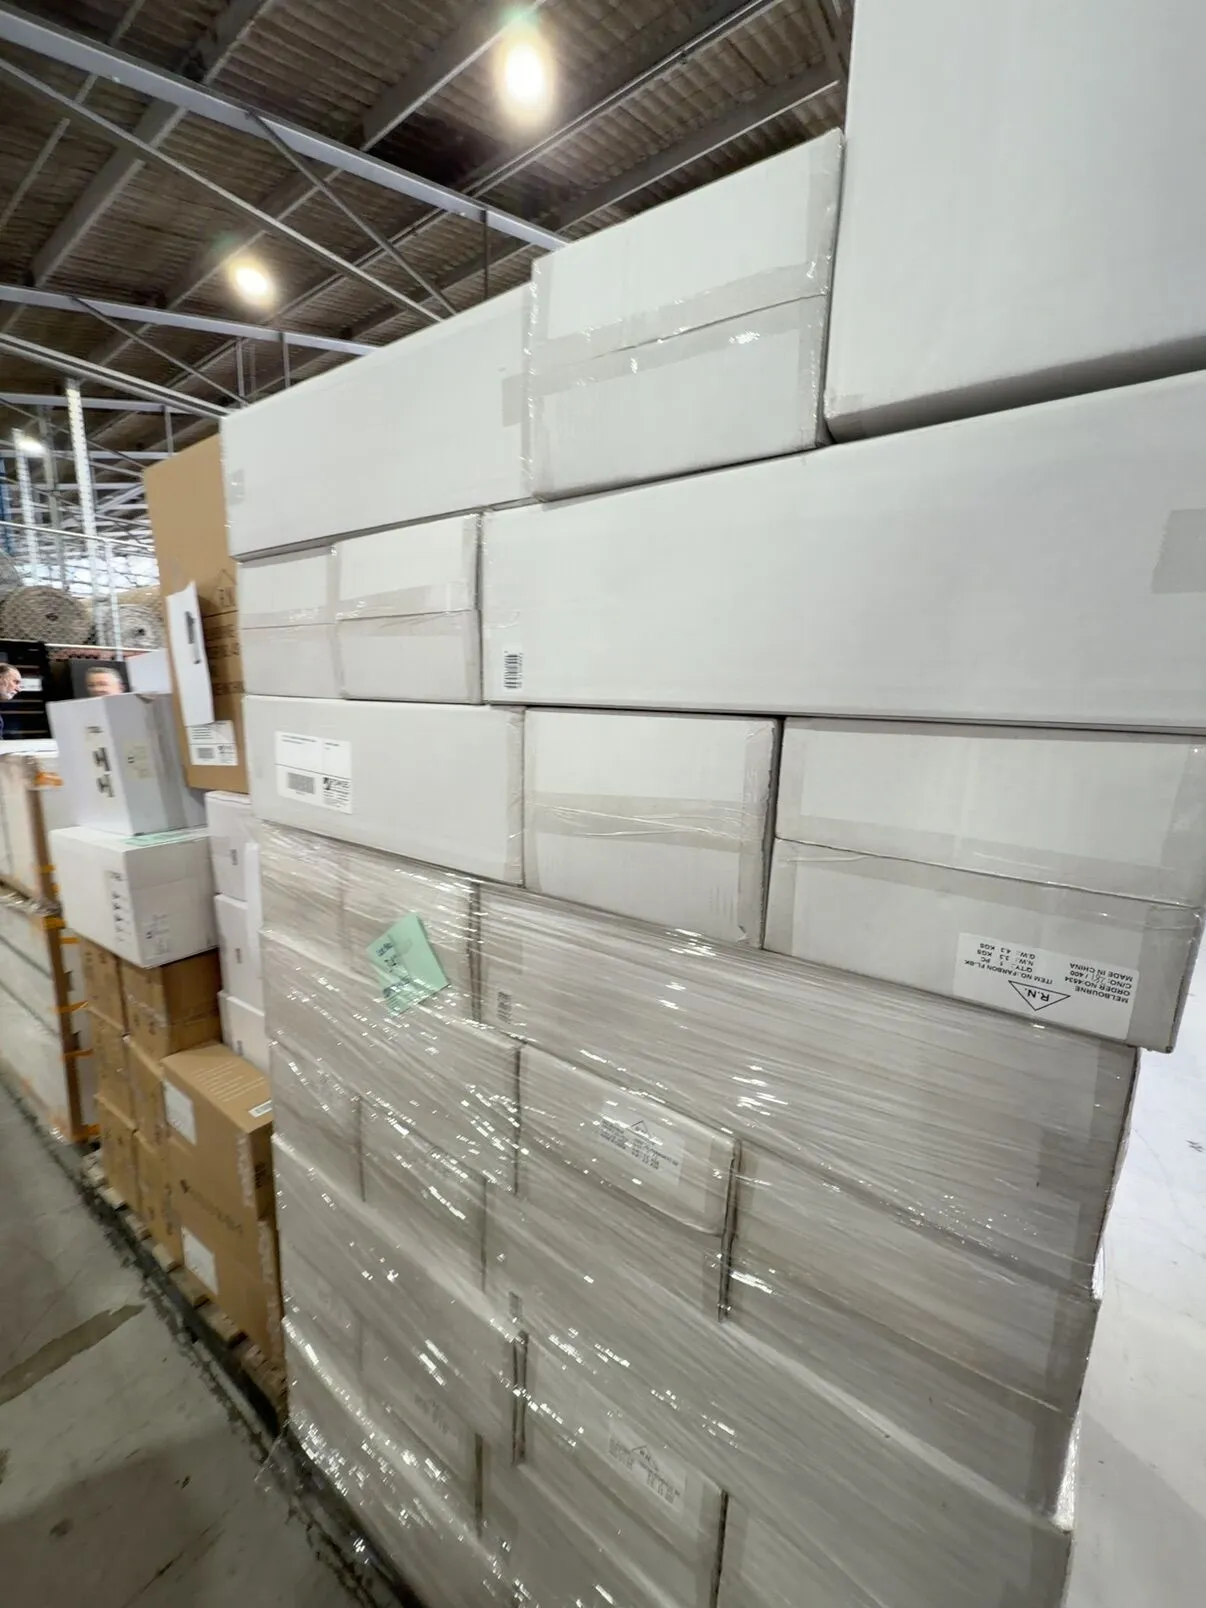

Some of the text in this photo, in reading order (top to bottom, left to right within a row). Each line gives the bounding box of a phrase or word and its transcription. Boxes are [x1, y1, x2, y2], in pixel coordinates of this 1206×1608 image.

[1070, 963, 1095, 974] CHINA
[1070, 970, 1084, 978] 400
[1108, 972, 1133, 982] MADE
[1034, 976, 1052, 985] ITEM
[1099, 983, 1130, 996] ORDER
[1074, 986, 1128, 1004] MELBOURNE
